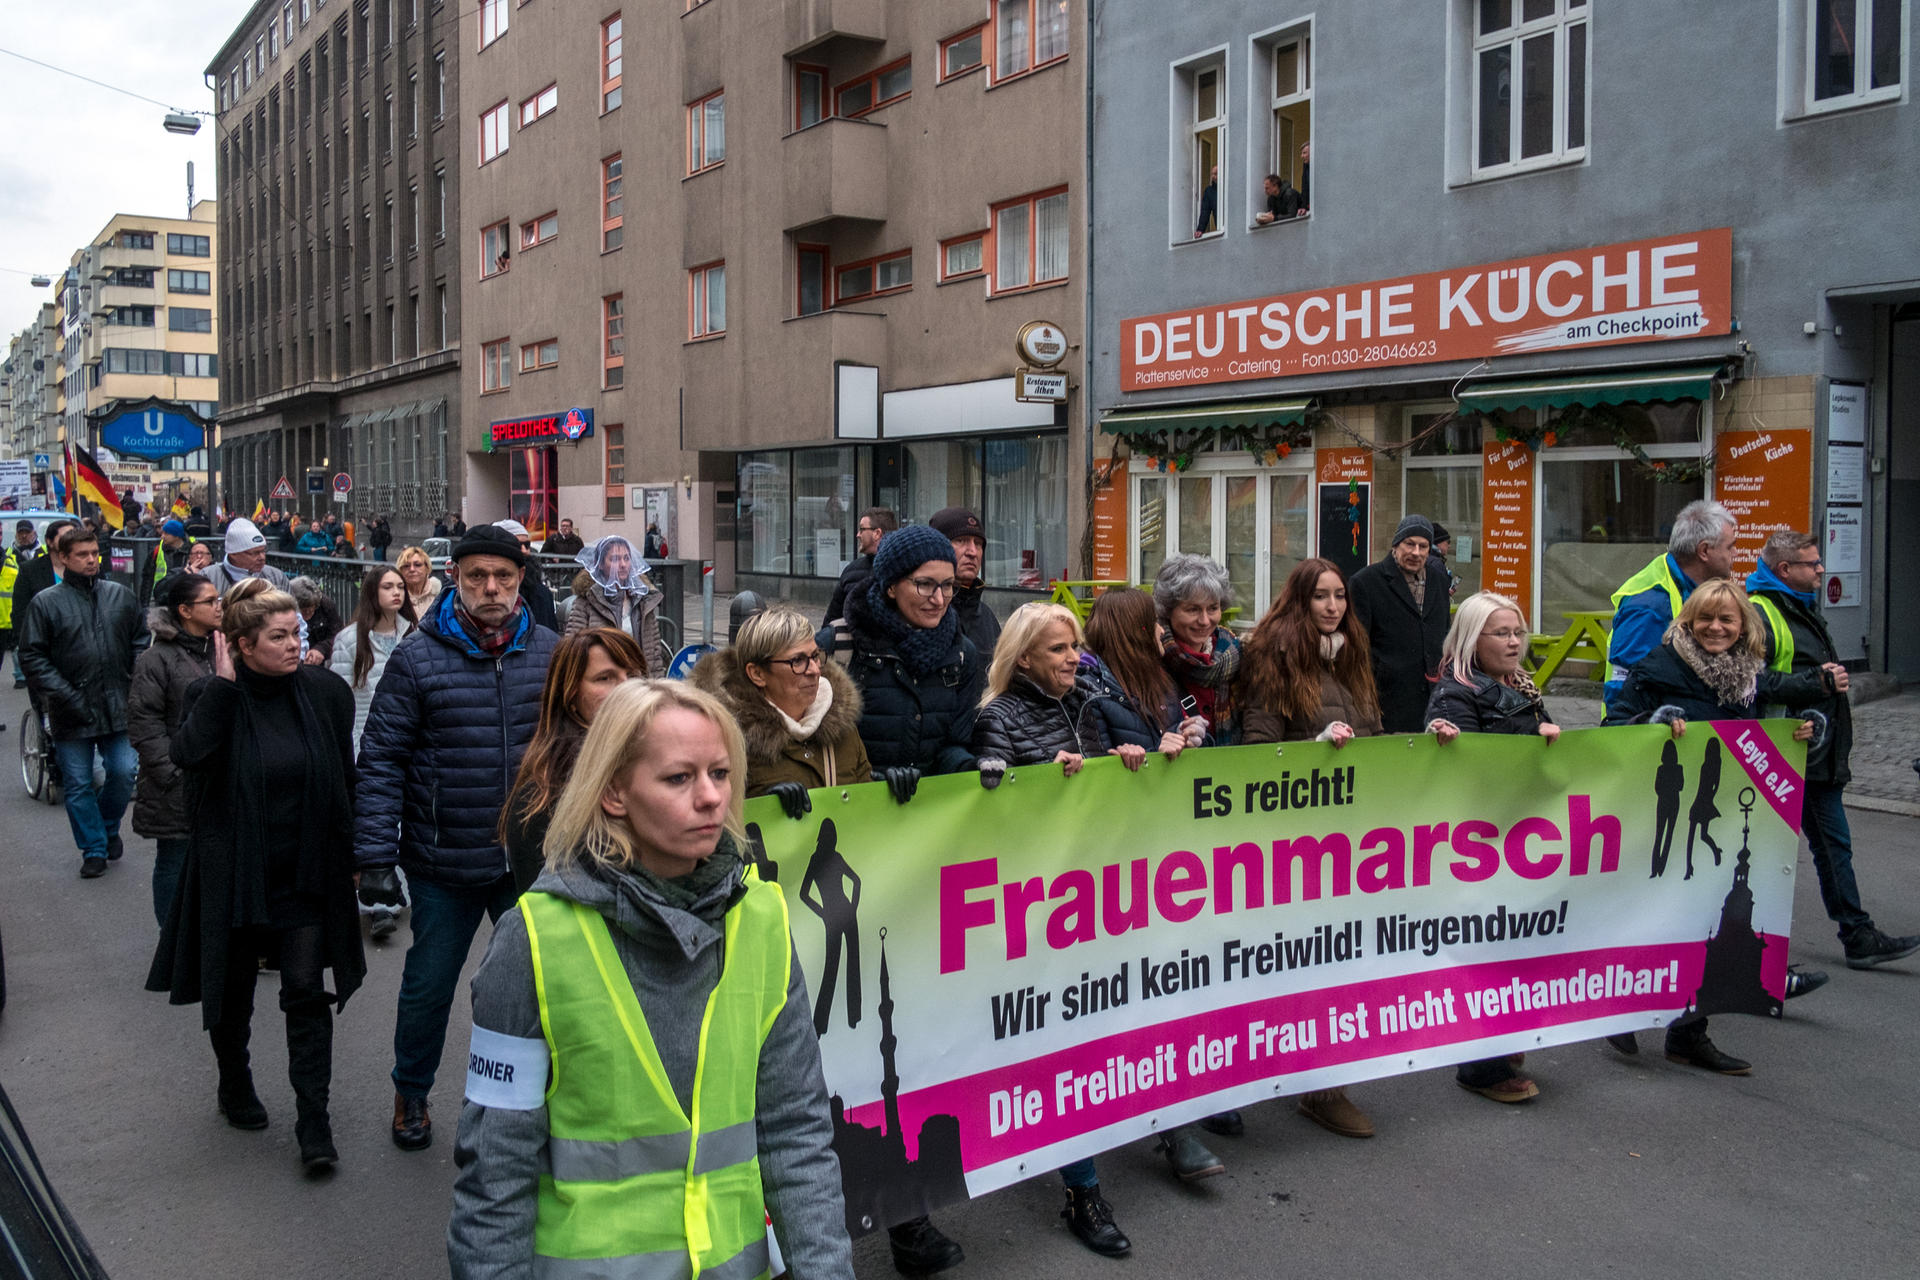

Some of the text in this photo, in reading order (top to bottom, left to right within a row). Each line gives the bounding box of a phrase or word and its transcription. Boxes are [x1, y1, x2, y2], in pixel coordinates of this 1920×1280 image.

[1135, 241, 1699, 366] DEUTSCHE KÜCHE
[1566, 311, 1699, 339] am Checkpoint
[1026, 377, 1062, 387] Restaurant
[1135, 366, 1209, 385] Plattenservice
[1228, 357, 1281, 376] Catering
[1034, 386, 1055, 395] Athen
[144, 412, 164, 436] U
[492, 418, 559, 441] SPIELOTHEK
[123, 436, 184, 447] Kochstraße
[1730, 433, 1772, 459] Deutsche
[1764, 442, 1794, 463] Küche
[1488, 452, 1500, 465] Für
[1507, 453, 1528, 471] Durst
[1723, 483, 1762, 491] Kartoffelsalat
[1724, 475, 1765, 483] Würstchen mit
[1723, 499, 1770, 508] Kräuterquark mit
[1739, 523, 1749, 531] mit
[1736, 729, 1795, 804] Leyla e.V.
[1194, 769, 1354, 820] Es reicht!
[940, 796, 1622, 974] Frauenmarsch
[991, 901, 1569, 1041] Wir sind kein Freiwild! Nirgendwo!
[989, 960, 1679, 1137] Die Freiheit der Frau ist nicht verhandelbar!
